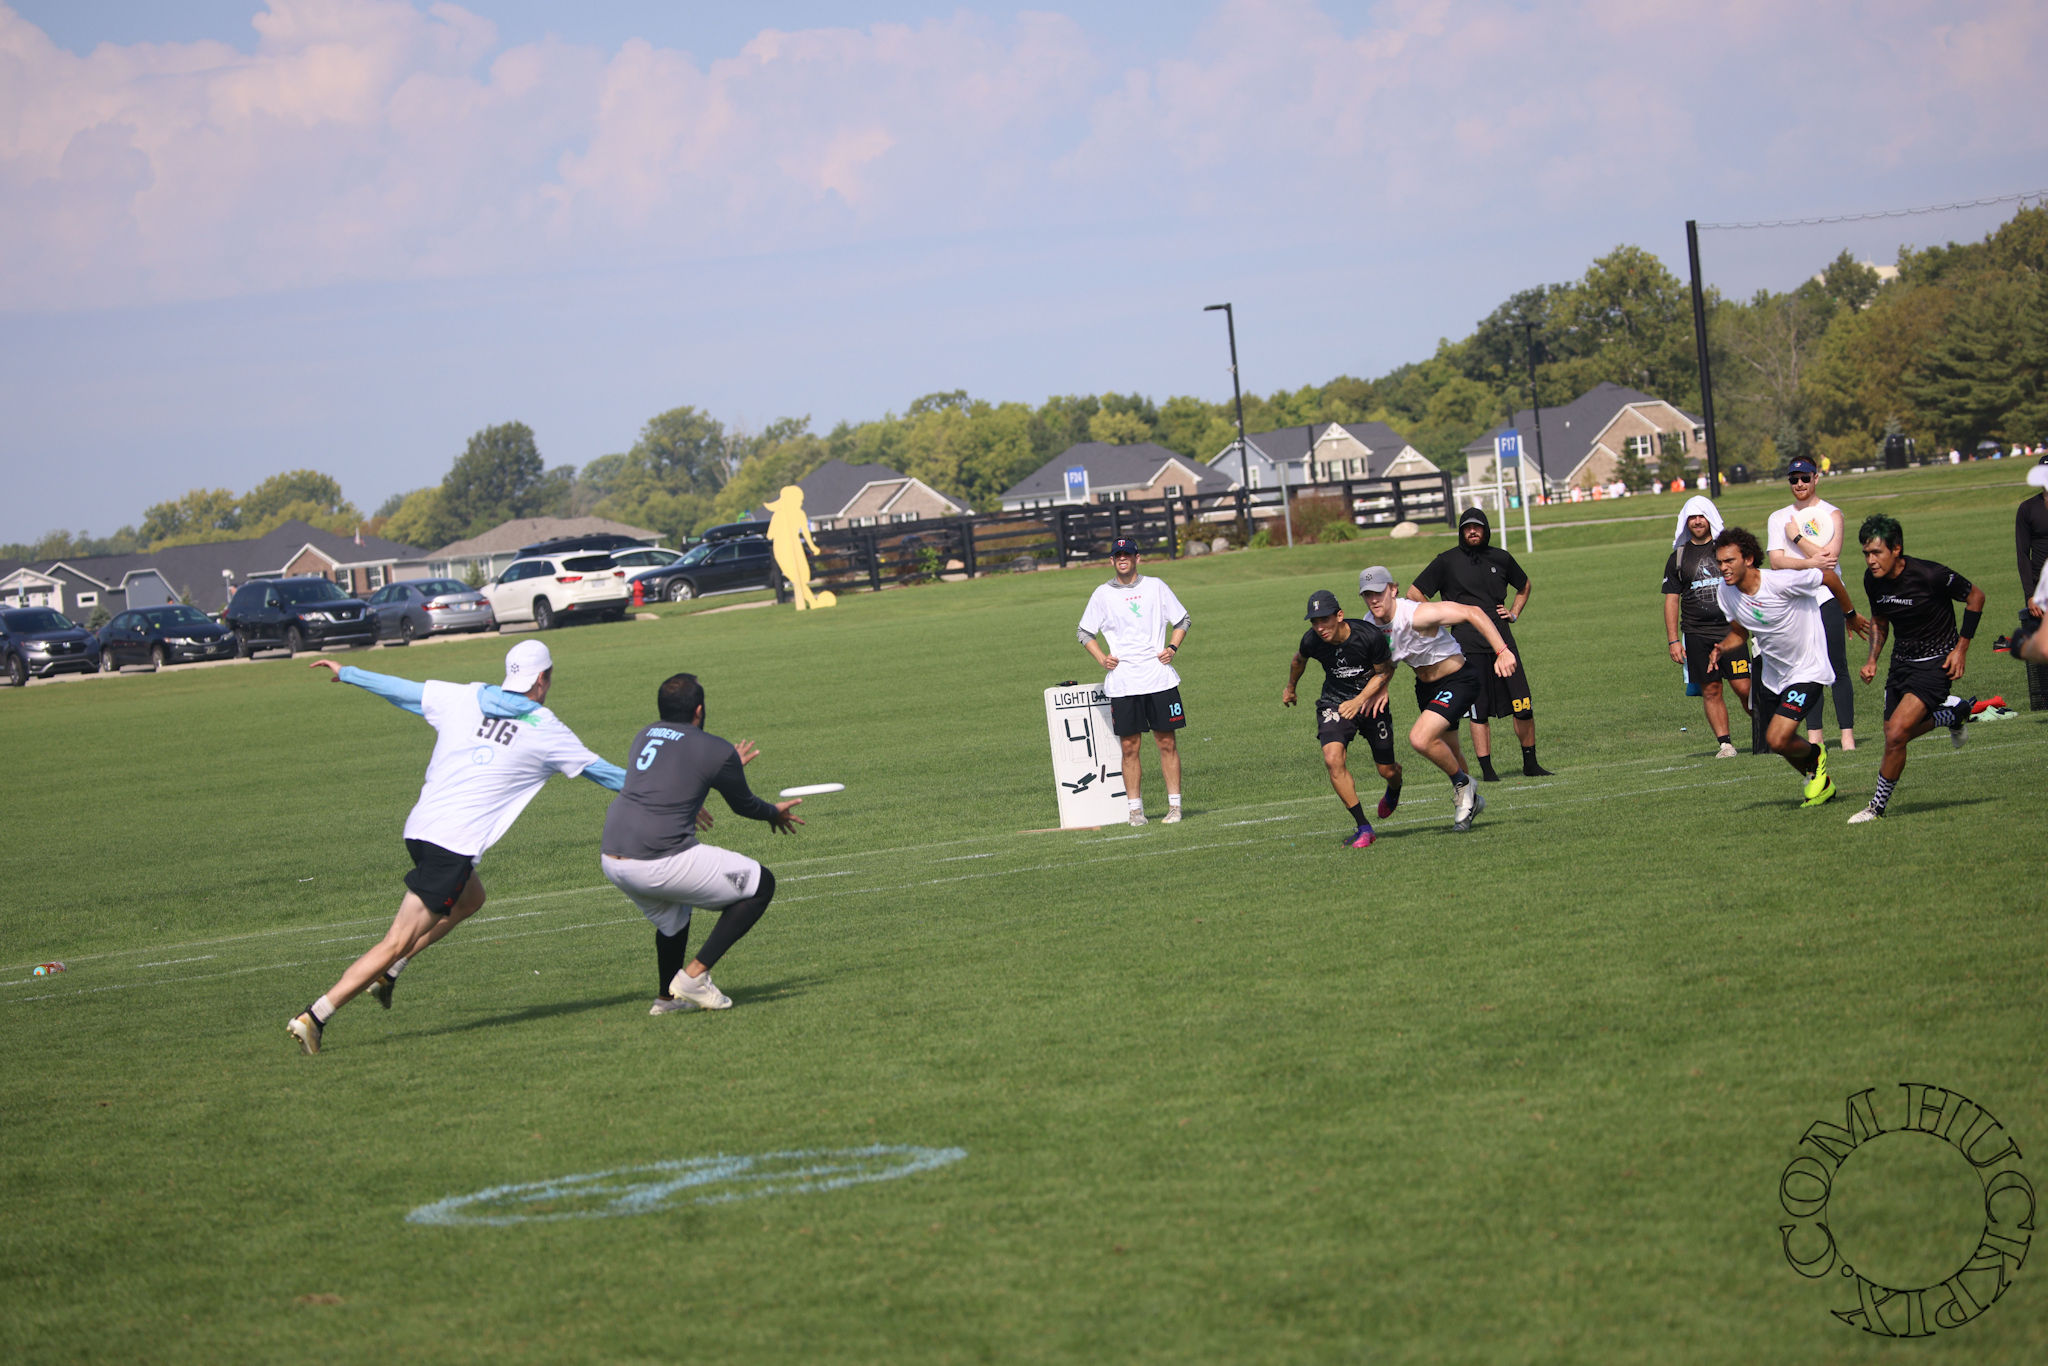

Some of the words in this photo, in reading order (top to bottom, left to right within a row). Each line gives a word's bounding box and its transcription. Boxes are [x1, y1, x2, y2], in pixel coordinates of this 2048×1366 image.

[1501, 437, 1515, 452] F17
[1731, 660, 1748, 674] 12
[1055, 692, 1085, 706] LIGHT
[1091, 690, 1110, 703] DA
[1512, 697, 1531, 713] 94
[1787, 690, 1807, 706] 94
[1169, 703, 1182, 717] 18
[477, 717, 518, 746] 96
[646, 727, 685, 741] TRIDENT
[1064, 717, 1092, 758] 4
[1377, 721, 1388, 739] 3
[636, 739, 664, 771] 5
